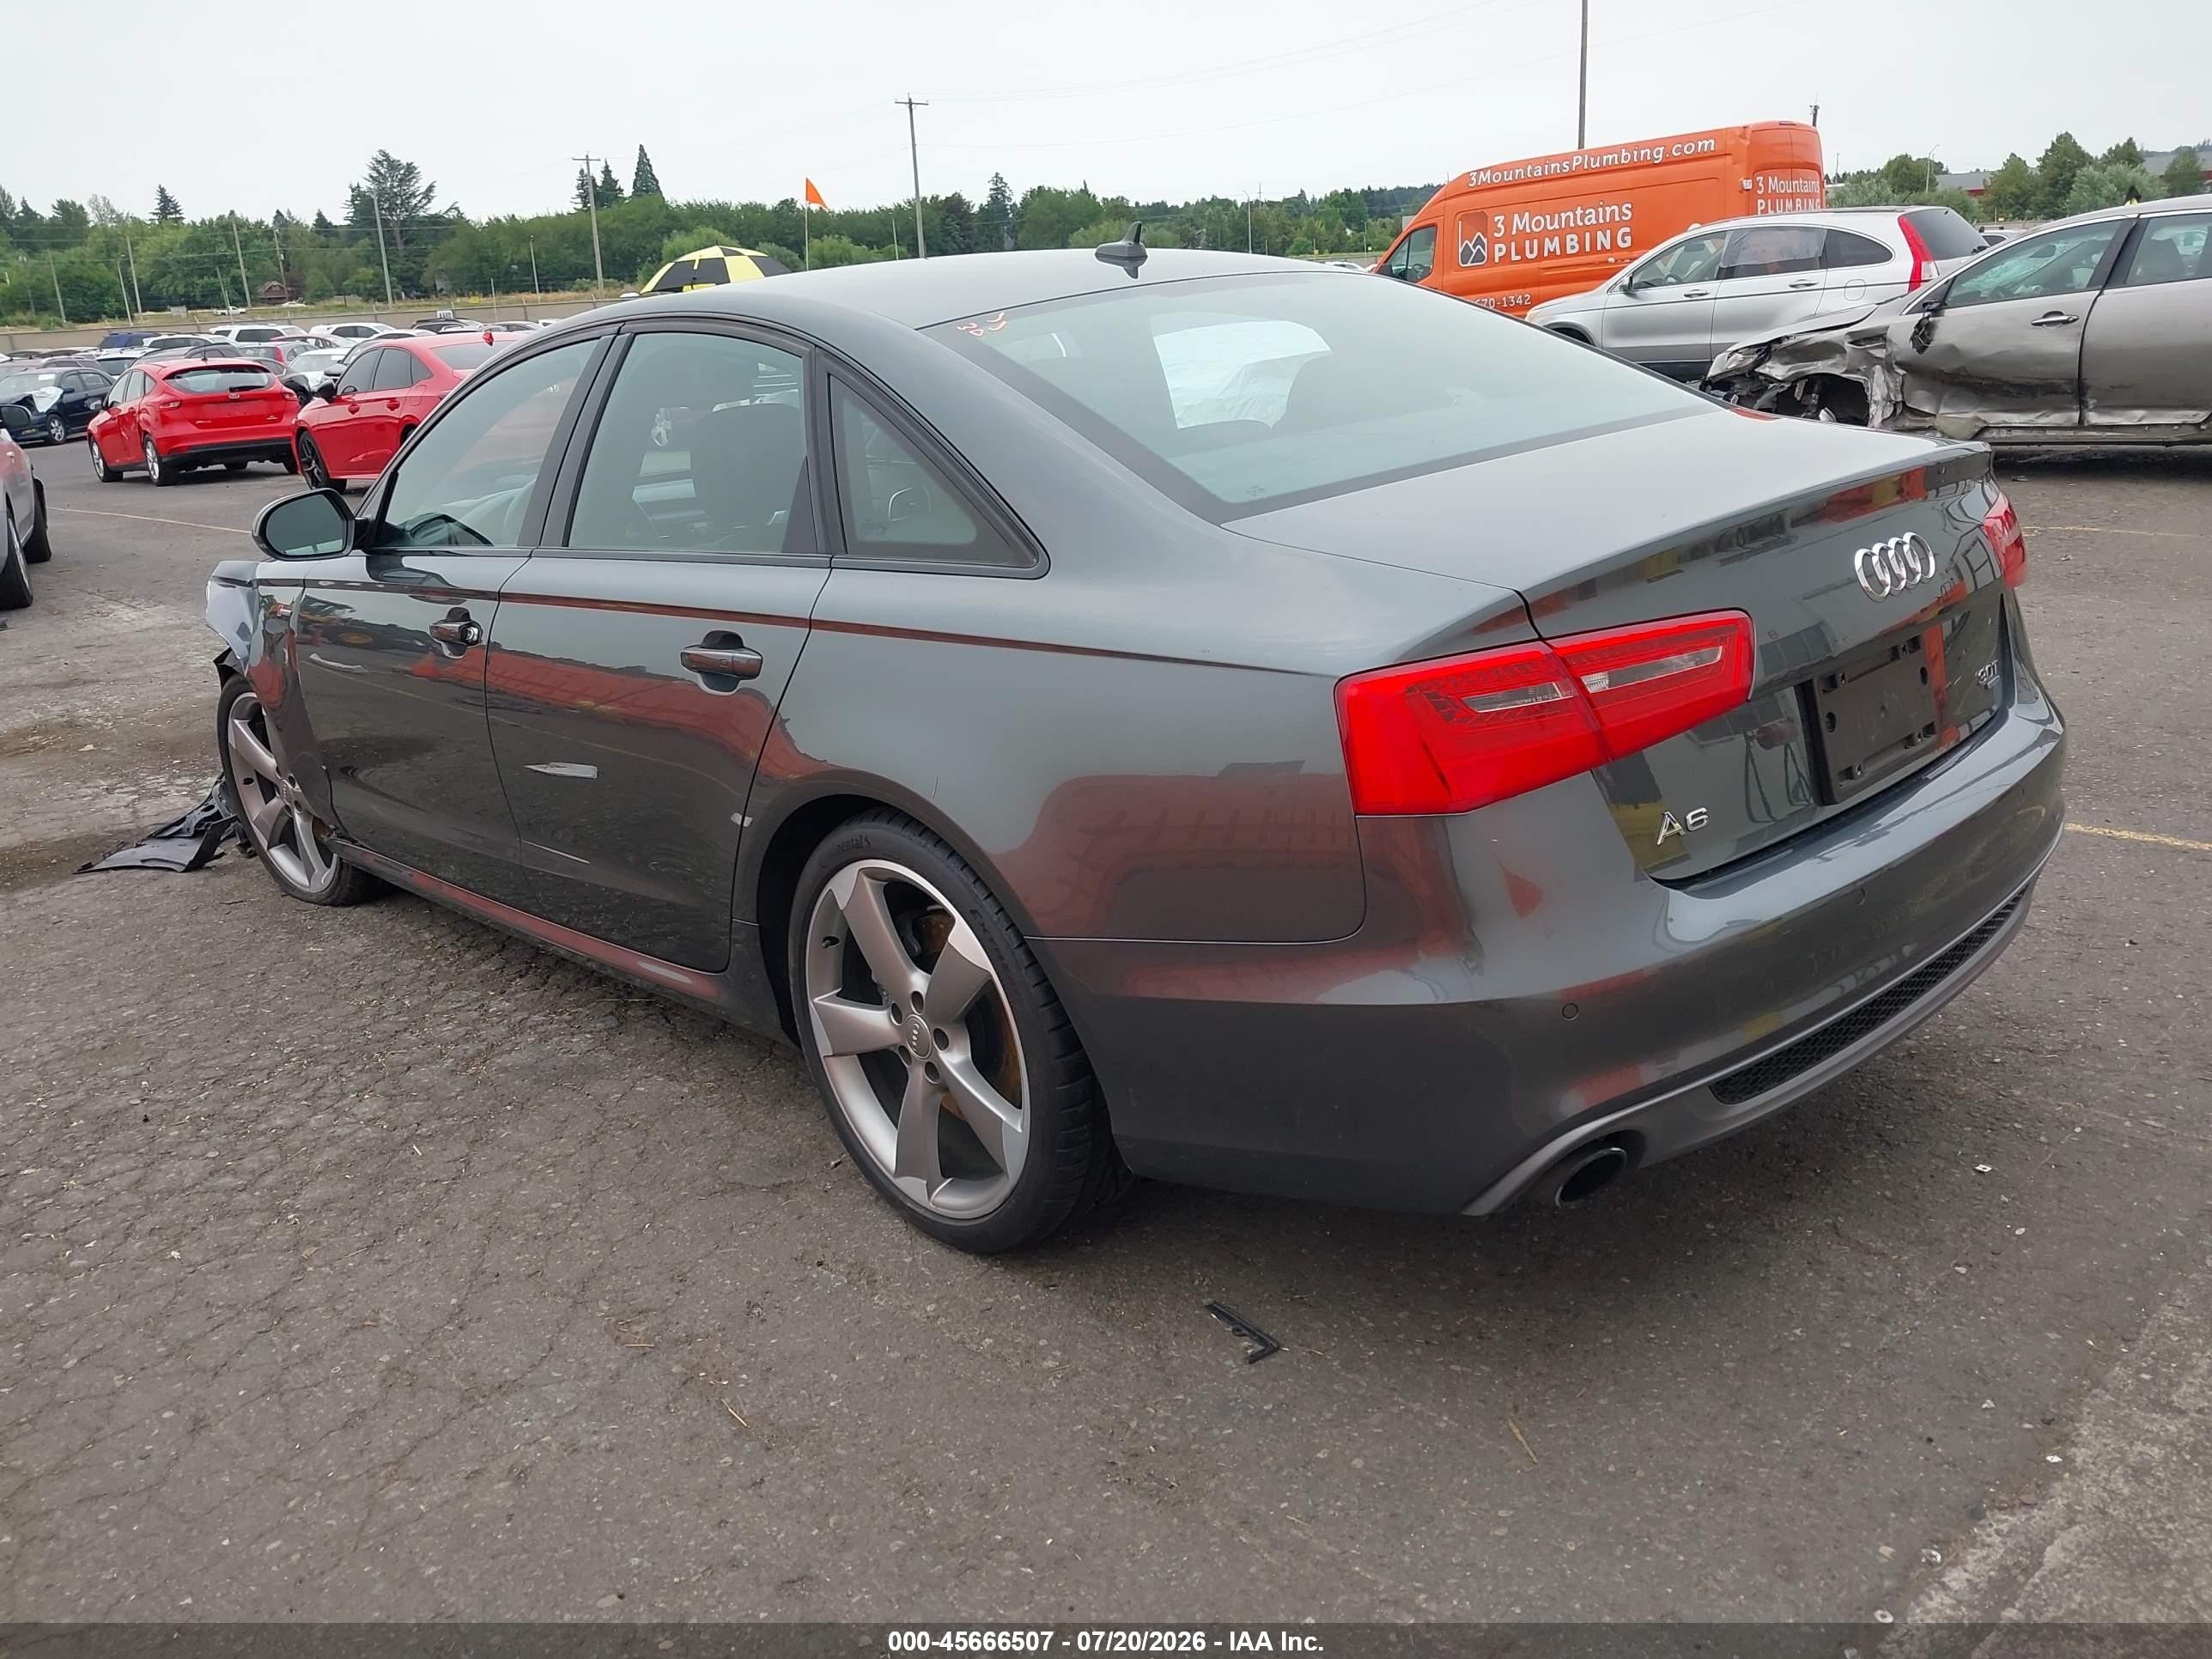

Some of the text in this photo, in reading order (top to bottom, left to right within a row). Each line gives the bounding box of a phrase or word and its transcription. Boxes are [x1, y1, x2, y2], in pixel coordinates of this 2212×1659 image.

[1468, 137, 1716, 187] 3MountainsPlumbing.com
[1756, 175, 1820, 195] 3 Mountains
[1492, 201, 1633, 238] 3 Mountains
[1757, 198, 1820, 215] PLUMBING
[1493, 227, 1632, 263] PLUMBING
[1656, 807, 1709, 846] A6
